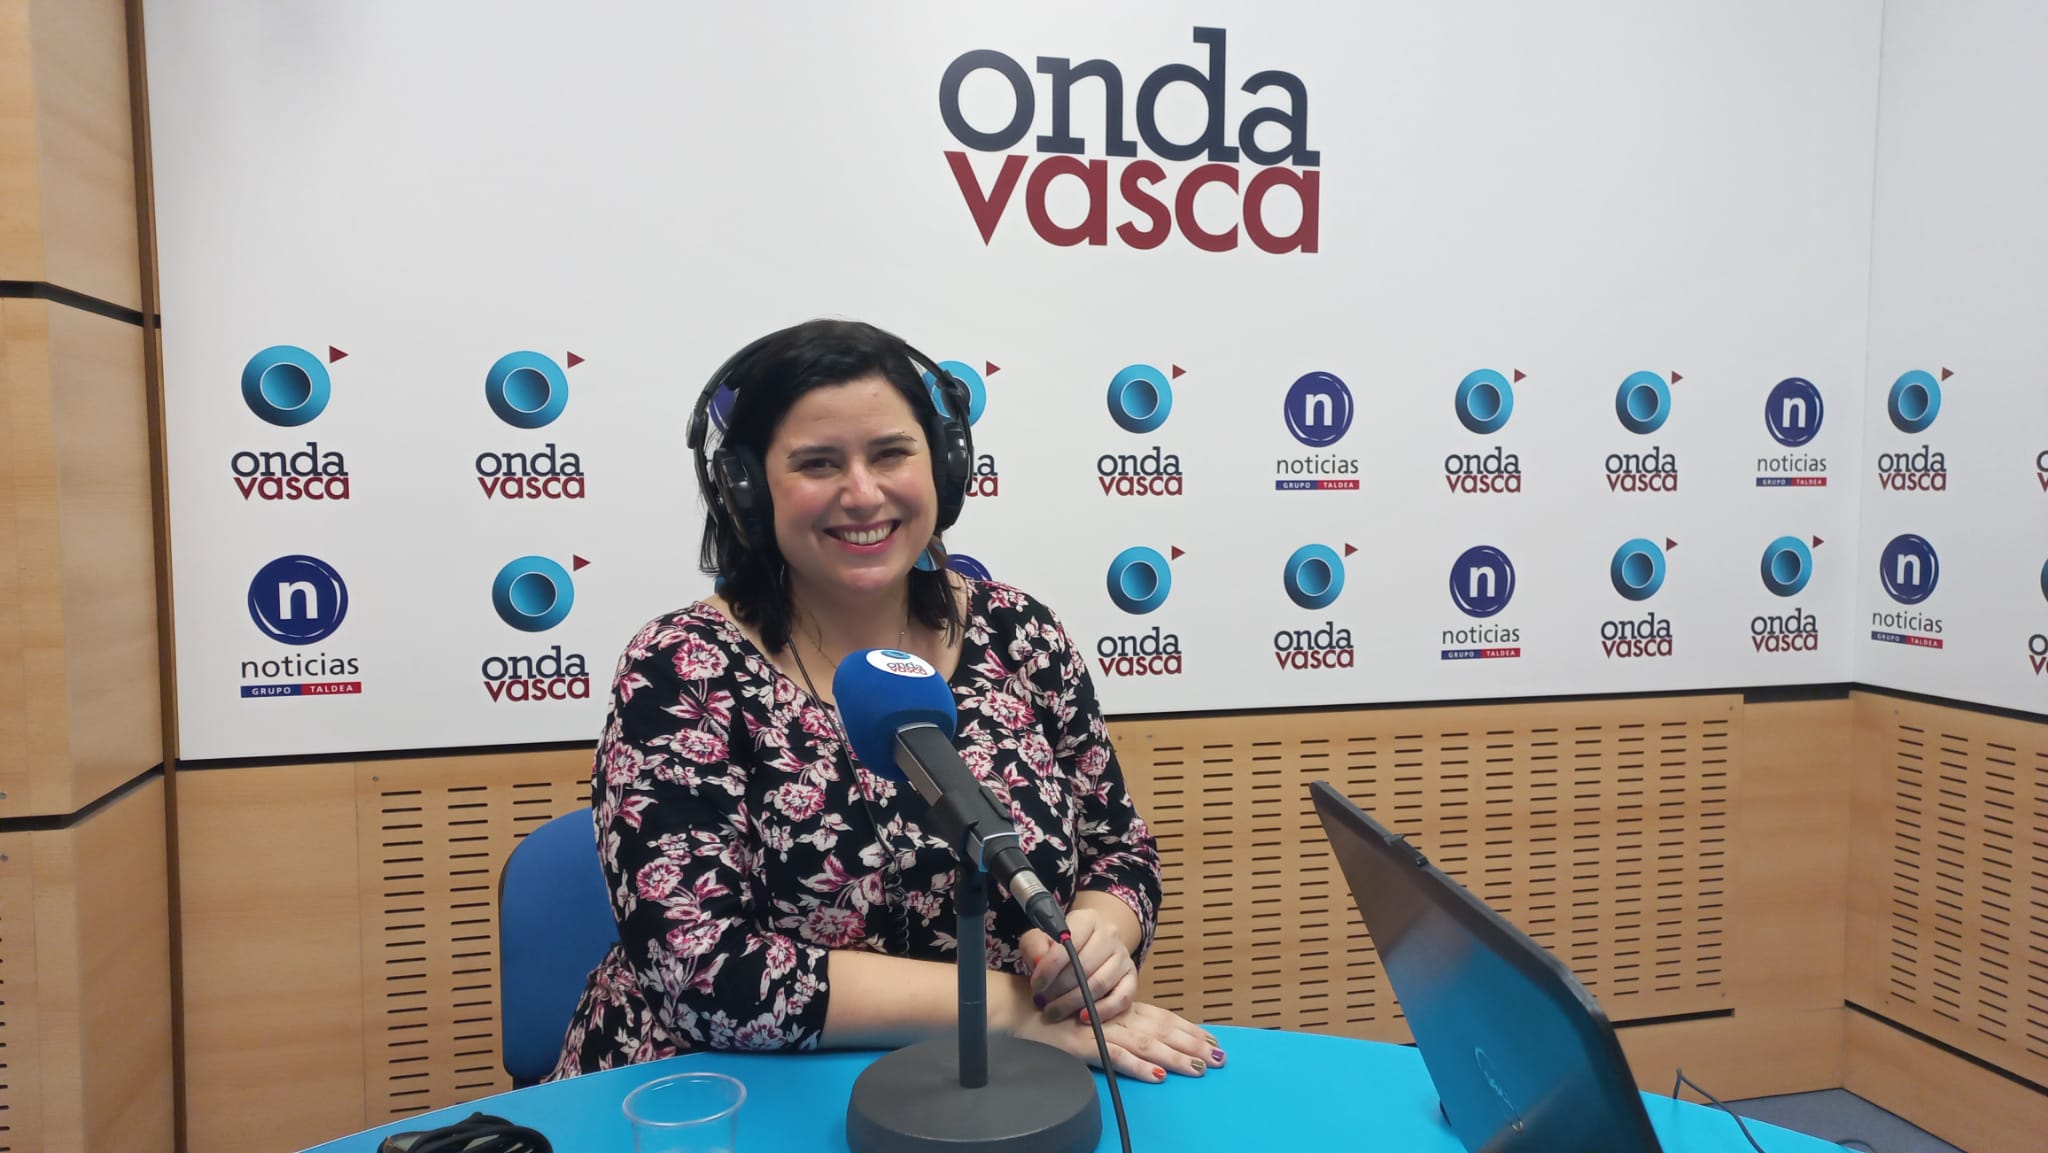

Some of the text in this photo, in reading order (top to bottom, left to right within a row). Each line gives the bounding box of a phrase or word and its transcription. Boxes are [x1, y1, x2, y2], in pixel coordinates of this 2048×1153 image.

[939, 26, 1320, 167] onda
[943, 151, 1320, 254] vasca
[1305, 393, 1333, 427] n
[1782, 397, 1805, 428] n
[231, 442, 348, 477] onda
[475, 443, 584, 477] onda
[1097, 447, 1182, 476] onda
[1276, 455, 1359, 474] noticias
[1445, 447, 1520, 475] onda
[1605, 447, 1677, 473] onda
[1757, 454, 1827, 473] noticias
[1878, 445, 1946, 473] onda
[233, 477, 350, 501] vasca
[477, 476, 585, 499] vasca
[1098, 475, 1183, 496] vasca
[1446, 474, 1521, 494] vasca
[1606, 472, 1677, 492] vasca
[1879, 472, 1946, 491] vasca
[1469, 565, 1495, 598] n
[1897, 554, 1920, 585] n
[278, 578, 318, 620] n
[1600, 612, 1672, 640] onda
[1751, 608, 1817, 636] onda
[1872, 610, 1942, 634] noticias
[1097, 627, 1180, 658] onda
[1274, 622, 1353, 650] onda
[1442, 625, 1520, 645] noticias
[1751, 633, 1818, 653] vasca
[1275, 648, 1354, 671] vasca
[1448, 649, 1515, 658] GRUPO TALDEA
[1601, 638, 1672, 658] vasca
[241, 653, 359, 678] noticias
[481, 645, 589, 681] onda
[886, 662, 923, 670] onda
[890, 667, 928, 675] vasca
[1098, 655, 1182, 677] vasca
[252, 684, 353, 695] GRUPO TALDEA
[483, 677, 589, 702] vasca
